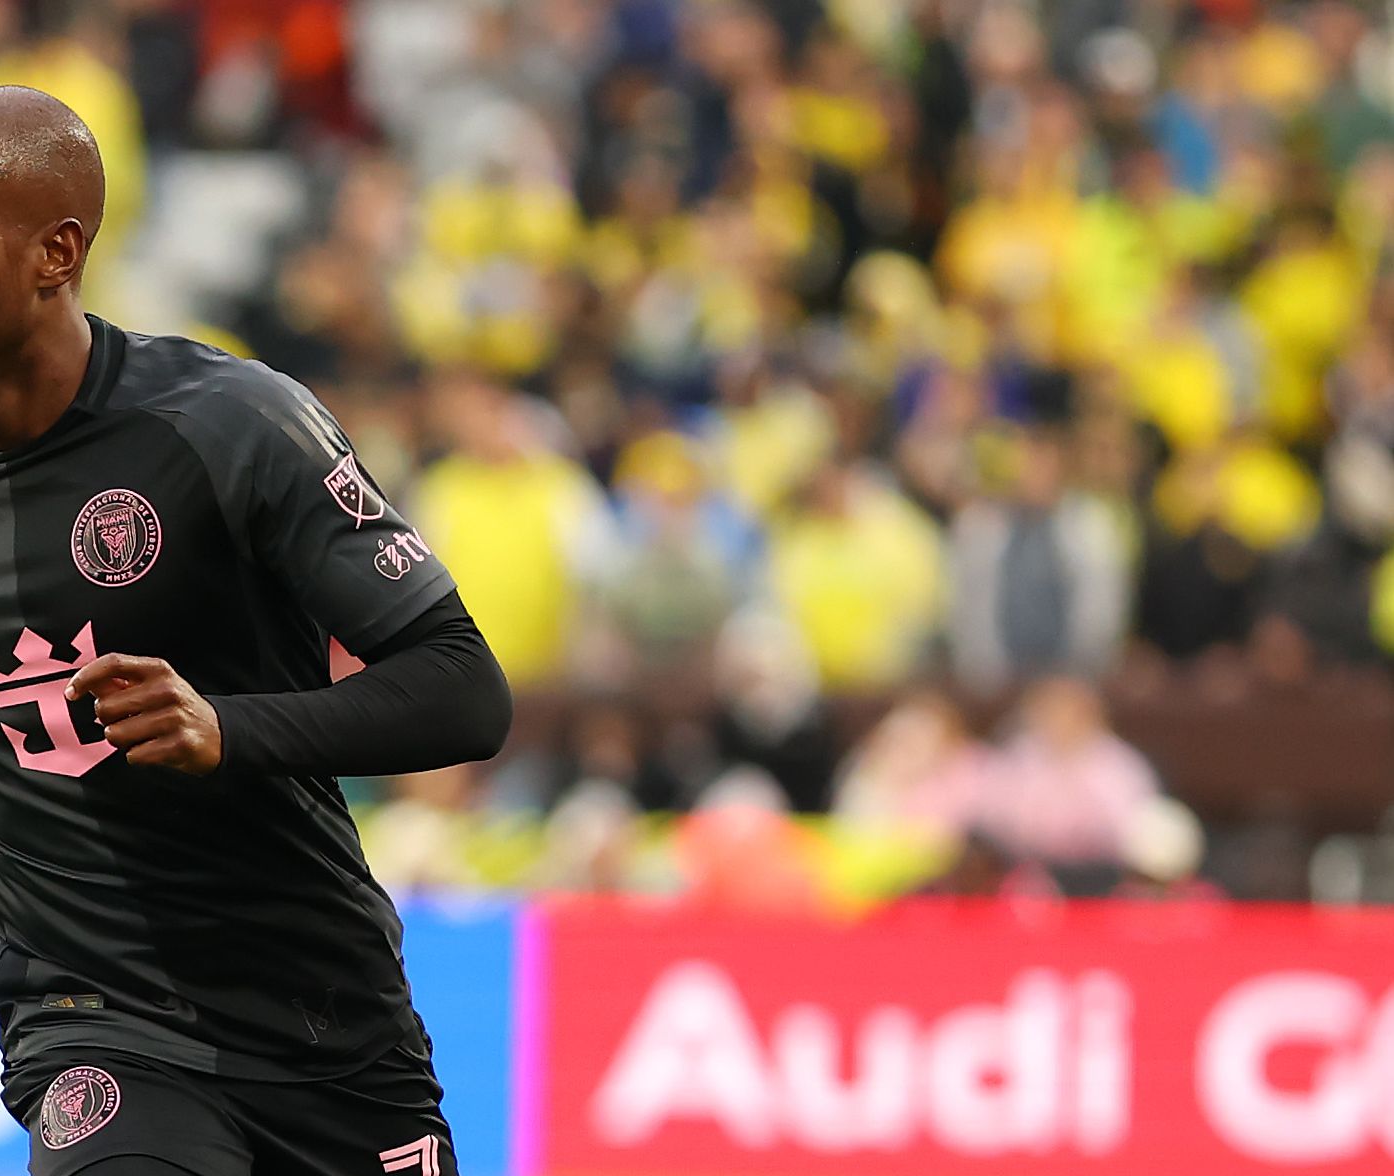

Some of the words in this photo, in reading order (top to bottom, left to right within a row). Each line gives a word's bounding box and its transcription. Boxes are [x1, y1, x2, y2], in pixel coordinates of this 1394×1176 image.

[138, 504, 150, 517] DE
[96, 513, 130, 527] MIAMI
[393, 527, 432, 562] tv
[105, 570, 134, 582] MMXX
[591, 957, 1134, 1156] Audi
[1196, 968, 1394, 1164] G
